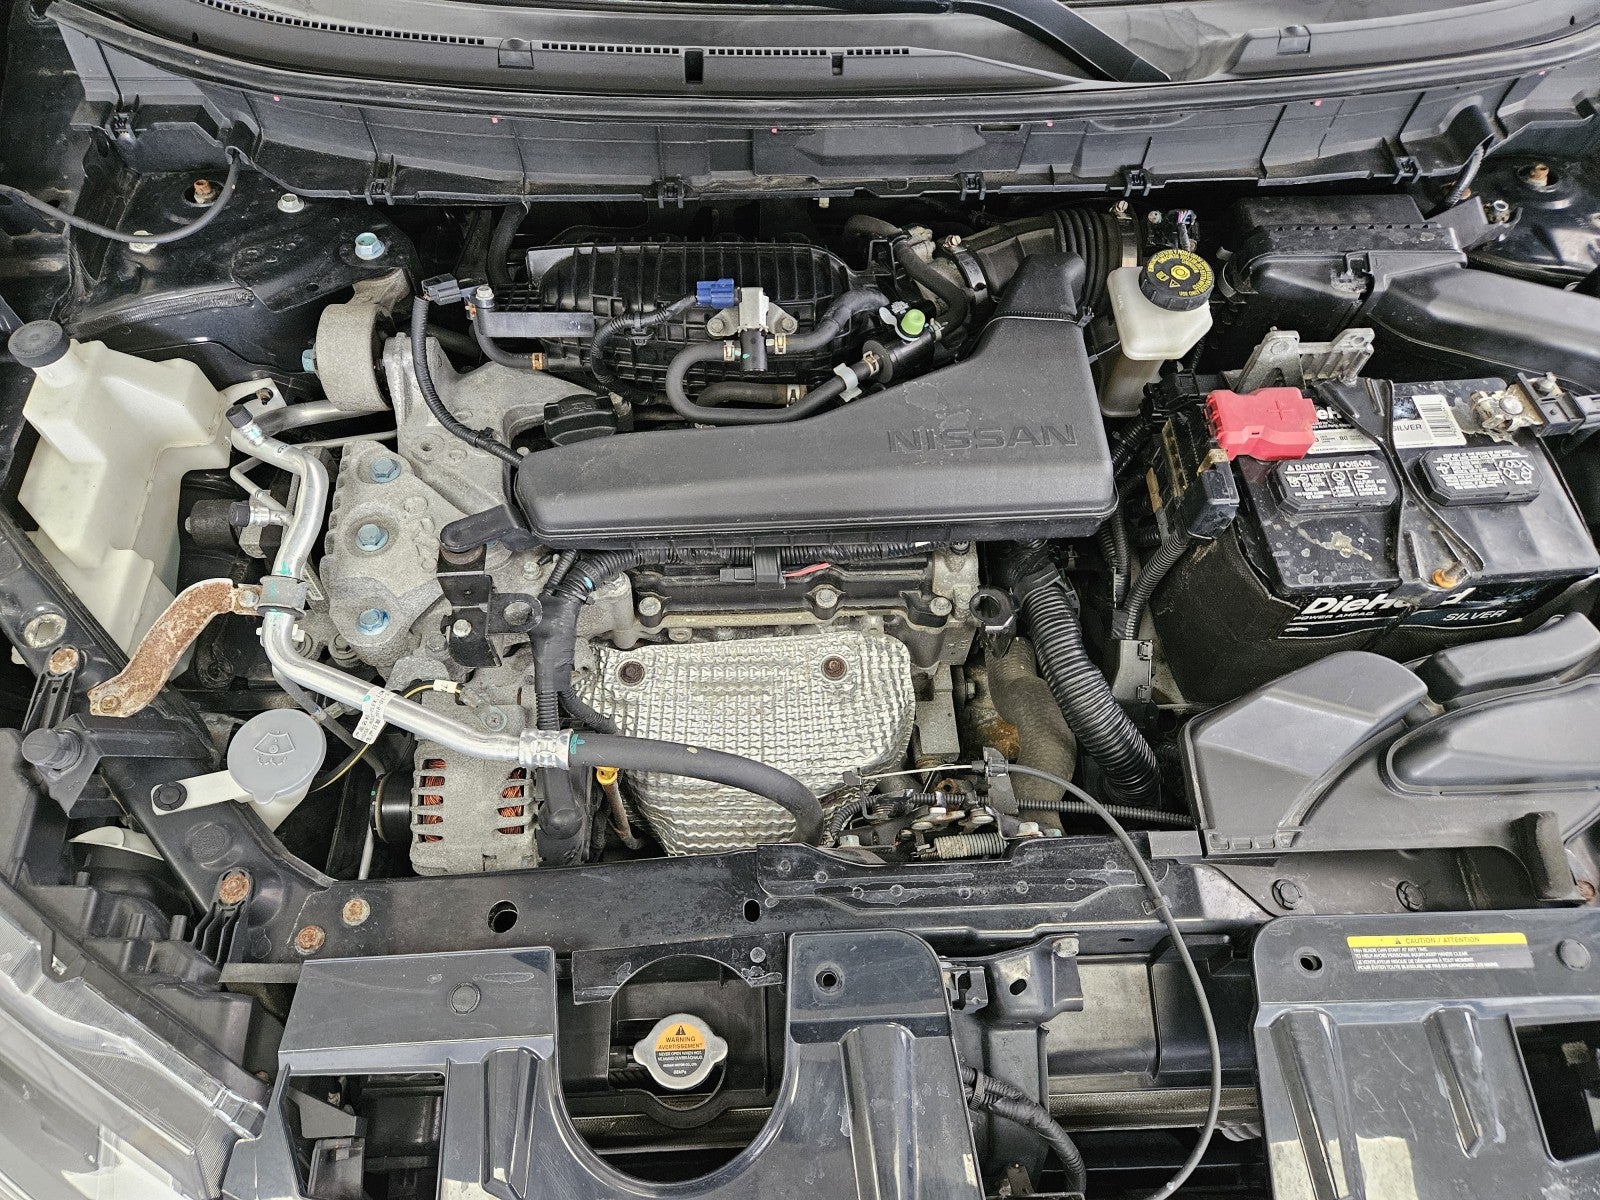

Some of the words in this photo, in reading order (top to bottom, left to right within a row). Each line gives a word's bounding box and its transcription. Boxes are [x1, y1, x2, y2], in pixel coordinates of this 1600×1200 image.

[887, 424, 1077, 452] NISSAN
[1295, 462, 1331, 471] DANGER
[1338, 460, 1372, 468] POISON
[1442, 609, 1507, 622] SILVER
